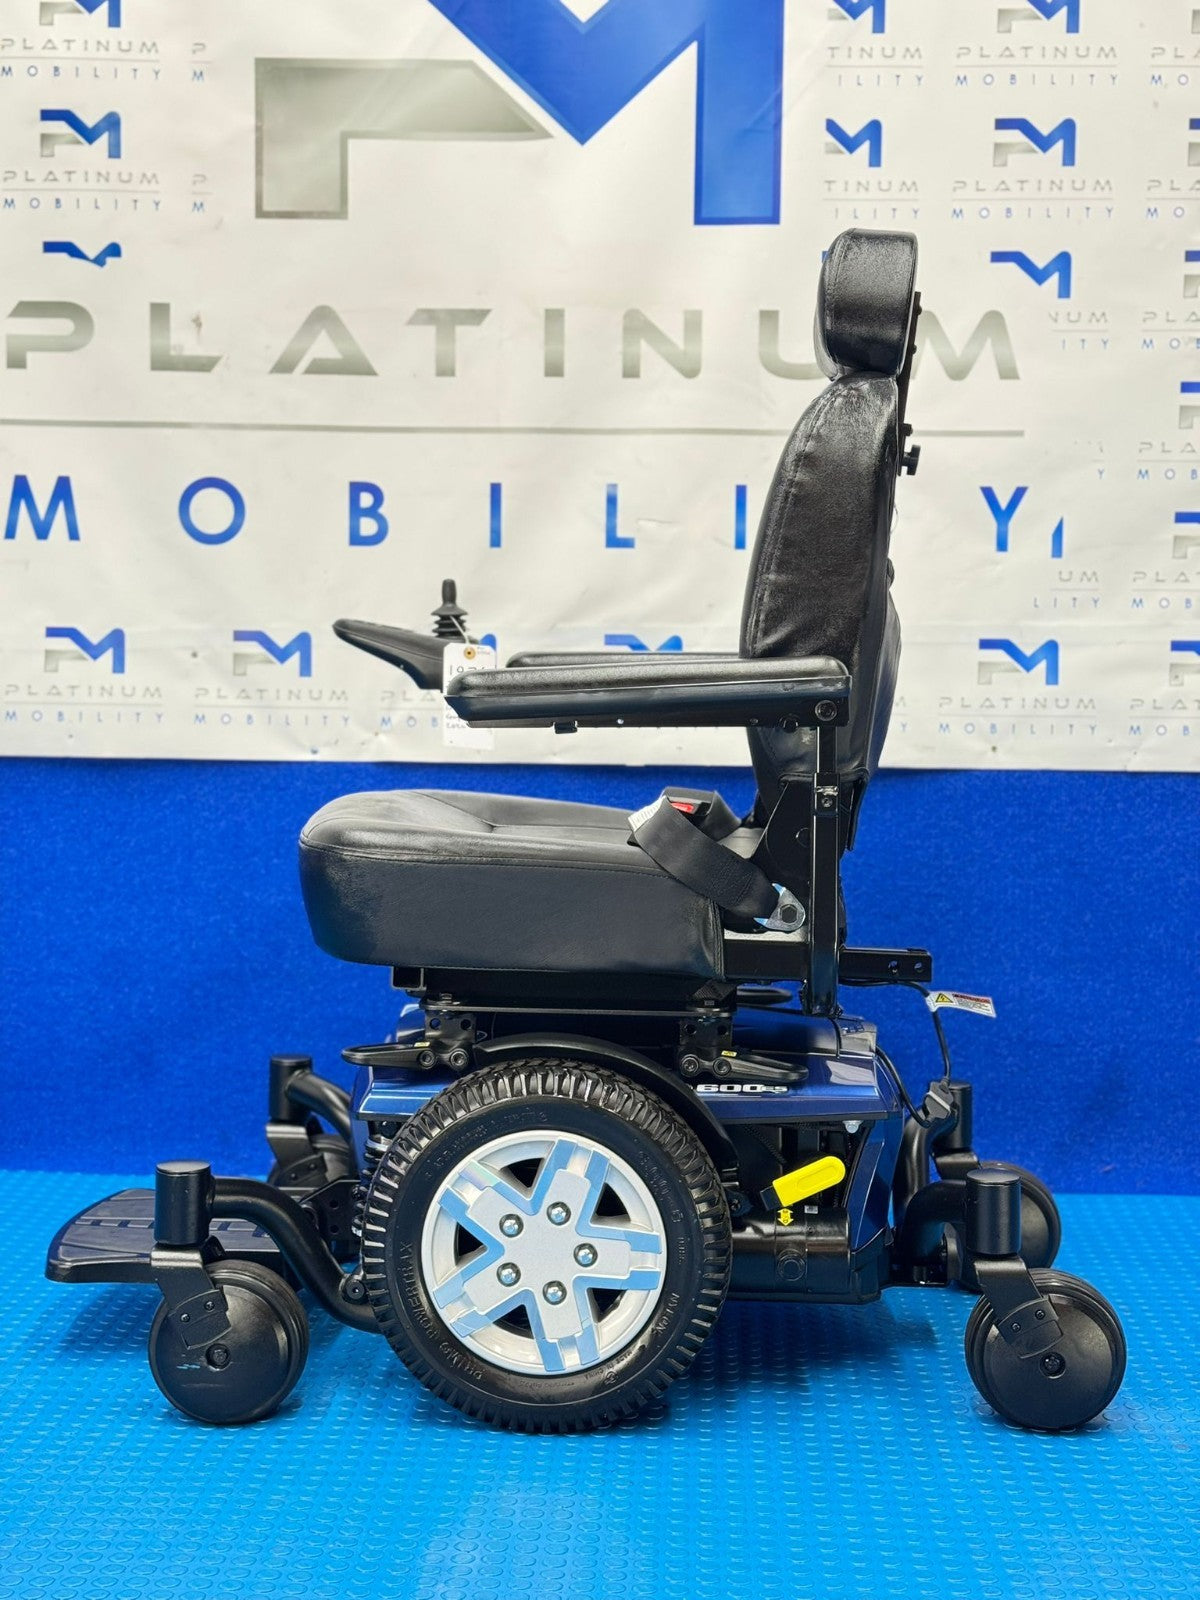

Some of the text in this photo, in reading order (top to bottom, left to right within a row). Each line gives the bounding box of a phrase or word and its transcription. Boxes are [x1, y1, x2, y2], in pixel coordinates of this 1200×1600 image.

[1, 38, 159, 53] PLATINUM
[956, 46, 1117, 58] PLATINUM
[1, 66, 160, 79] MOBILITY
[955, 74, 1118, 85] MOBILITY
[3, 171, 159, 184] PLATINUM
[952, 180, 1113, 191] PLATINUM
[3, 198, 160, 210] MOBILITY
[951, 207, 1113, 218] MOBILITY
[4, 475, 1028, 552] MOBILIY
[5, 685, 163, 698] PLATINUM
[194, 688, 349, 701] PLATINUM
[939, 698, 1096, 709] PLATINUM
[5, 711, 163, 722] MOBILITY
[194, 714, 349, 726] MOBILITY
[939, 723, 1096, 734] MOBILITY
